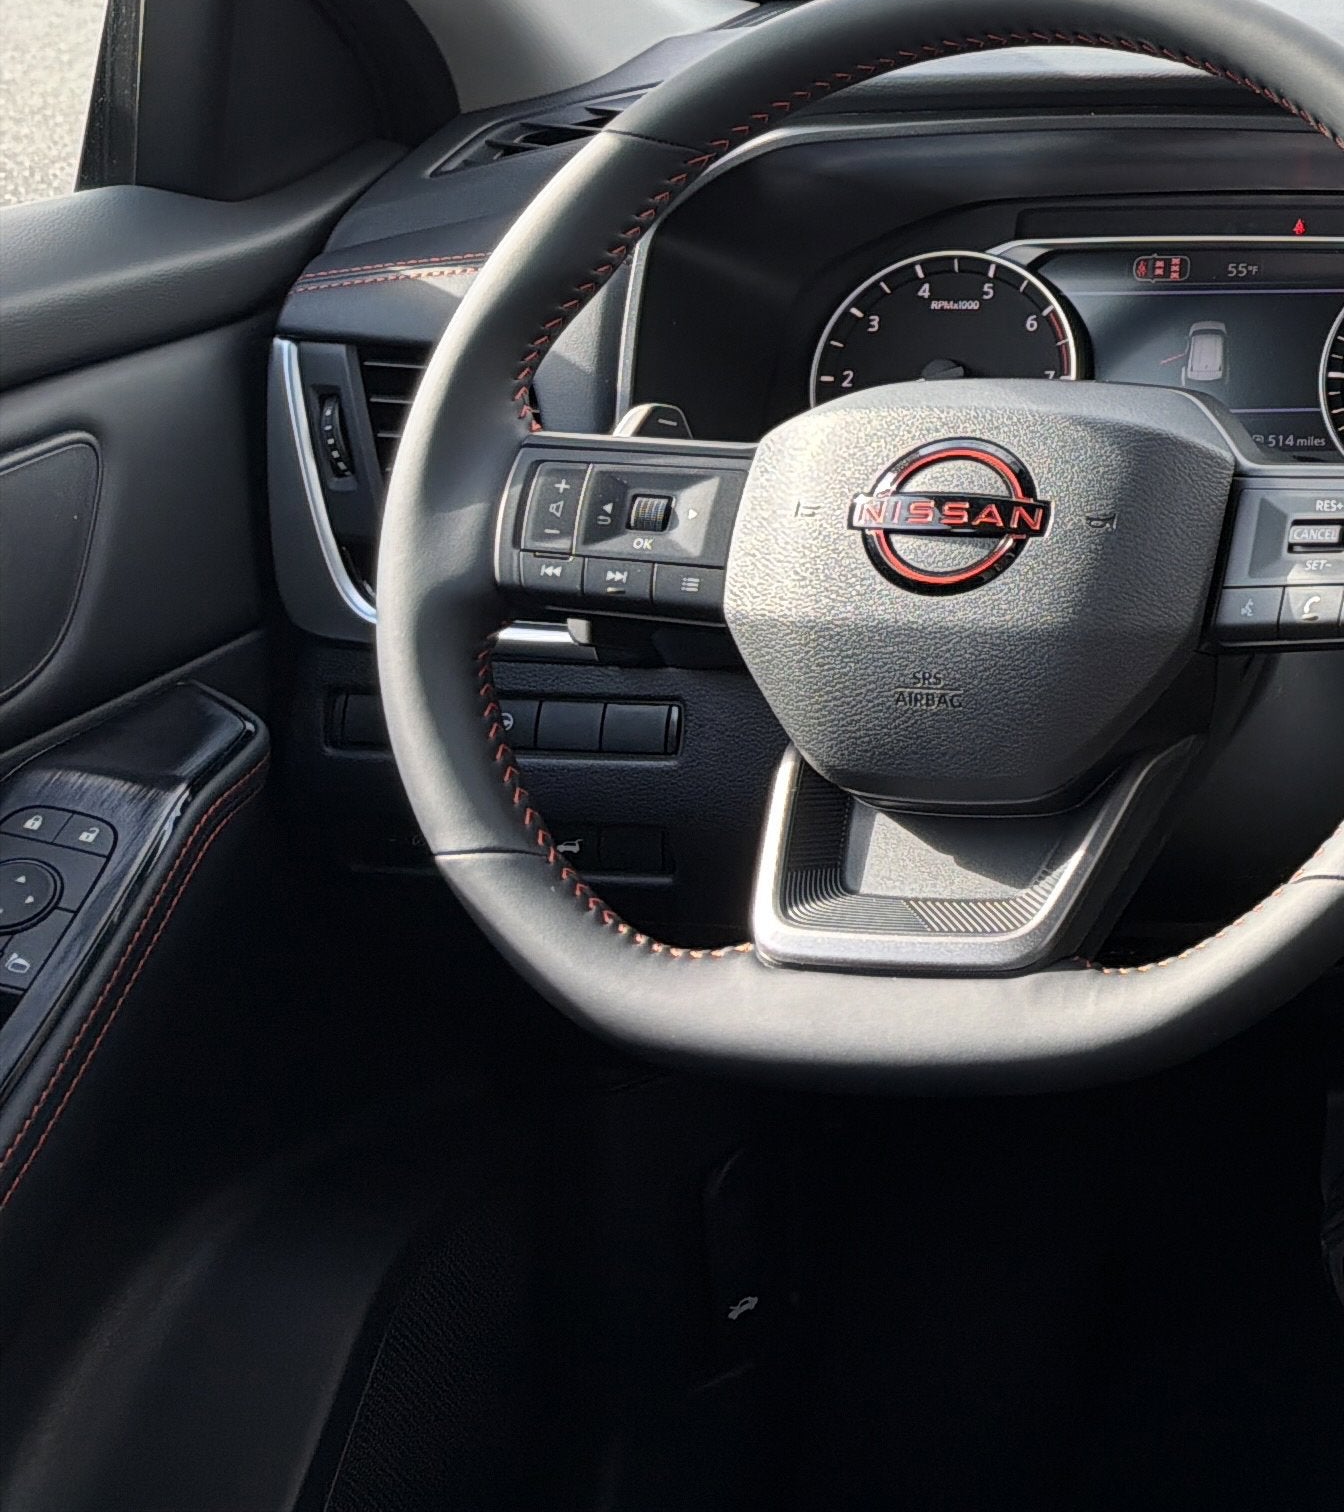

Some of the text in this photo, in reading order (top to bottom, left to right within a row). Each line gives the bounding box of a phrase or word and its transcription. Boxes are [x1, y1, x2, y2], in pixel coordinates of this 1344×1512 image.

[917, 282, 994, 300] 4 5
[931, 299, 981, 310] RPMx1000
[866, 314, 1039, 332] 3 6
[841, 369, 855, 388] 2
[1267, 434, 1327, 448] 514 miles
[1315, 499, 1344, 512] RES+
[858, 499, 1044, 531] NISSAN
[1293, 527, 1340, 541] CANCEL
[632, 538, 654, 551] OK
[911, 671, 943, 686] SRS
[894, 691, 963, 709] AIRBAG
